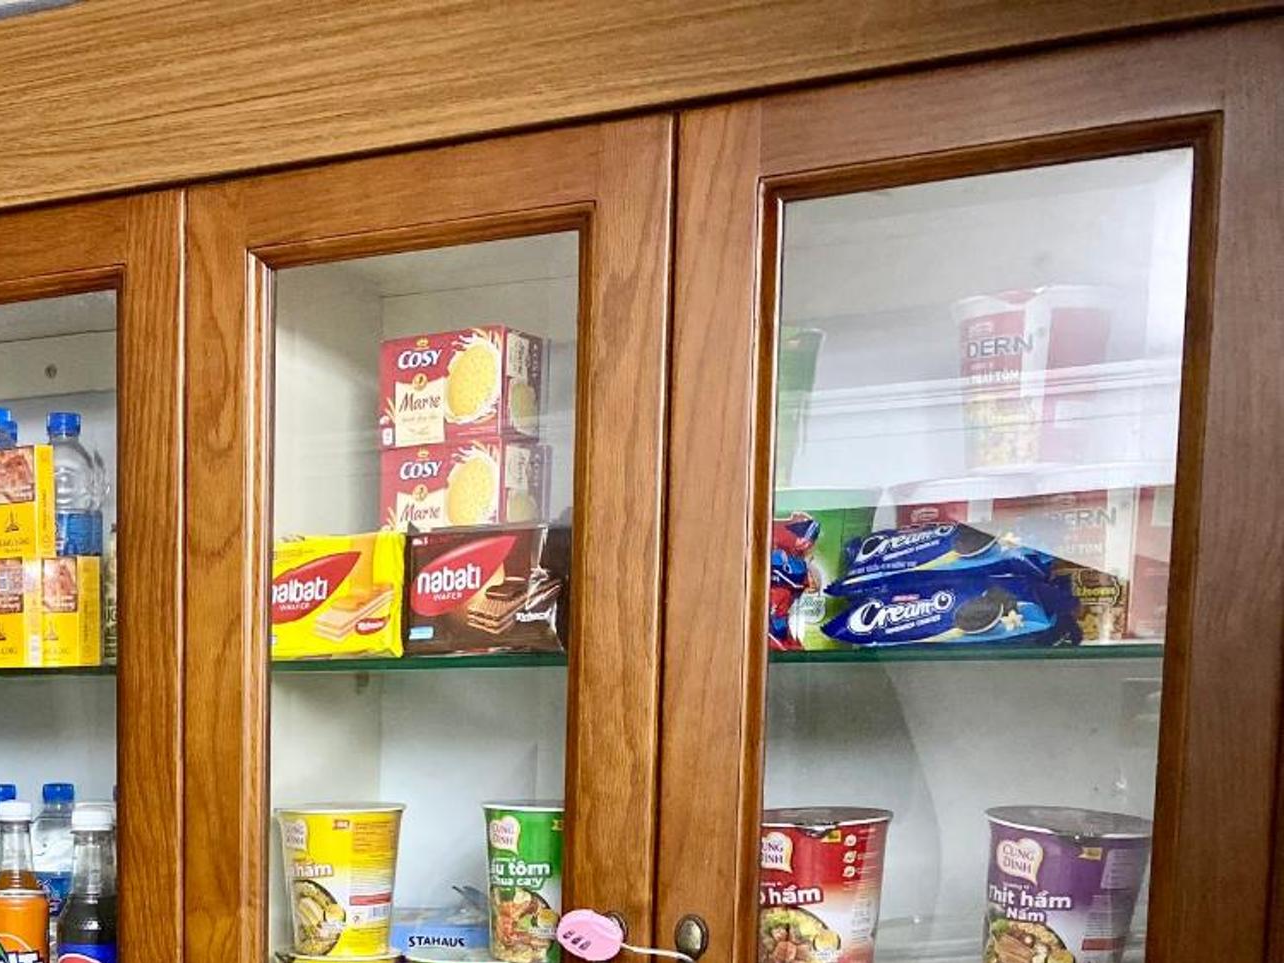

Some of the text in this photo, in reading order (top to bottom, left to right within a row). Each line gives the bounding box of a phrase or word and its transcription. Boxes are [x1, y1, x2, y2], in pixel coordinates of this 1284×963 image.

[397, 349, 442, 370] COSY
[399, 391, 440, 413] Marie
[399, 461, 442, 480] COSY
[400, 503, 440, 521] Marie
[417, 562, 480, 595] nabati
[847, 590, 955, 635] Cream-O
[762, 842, 784, 852] UNG
[1002, 843, 1035, 862] CUNG
[508, 860, 551, 876] tôm
[516, 876, 544, 889] cay
[408, 935, 465, 948] STAHAUS
